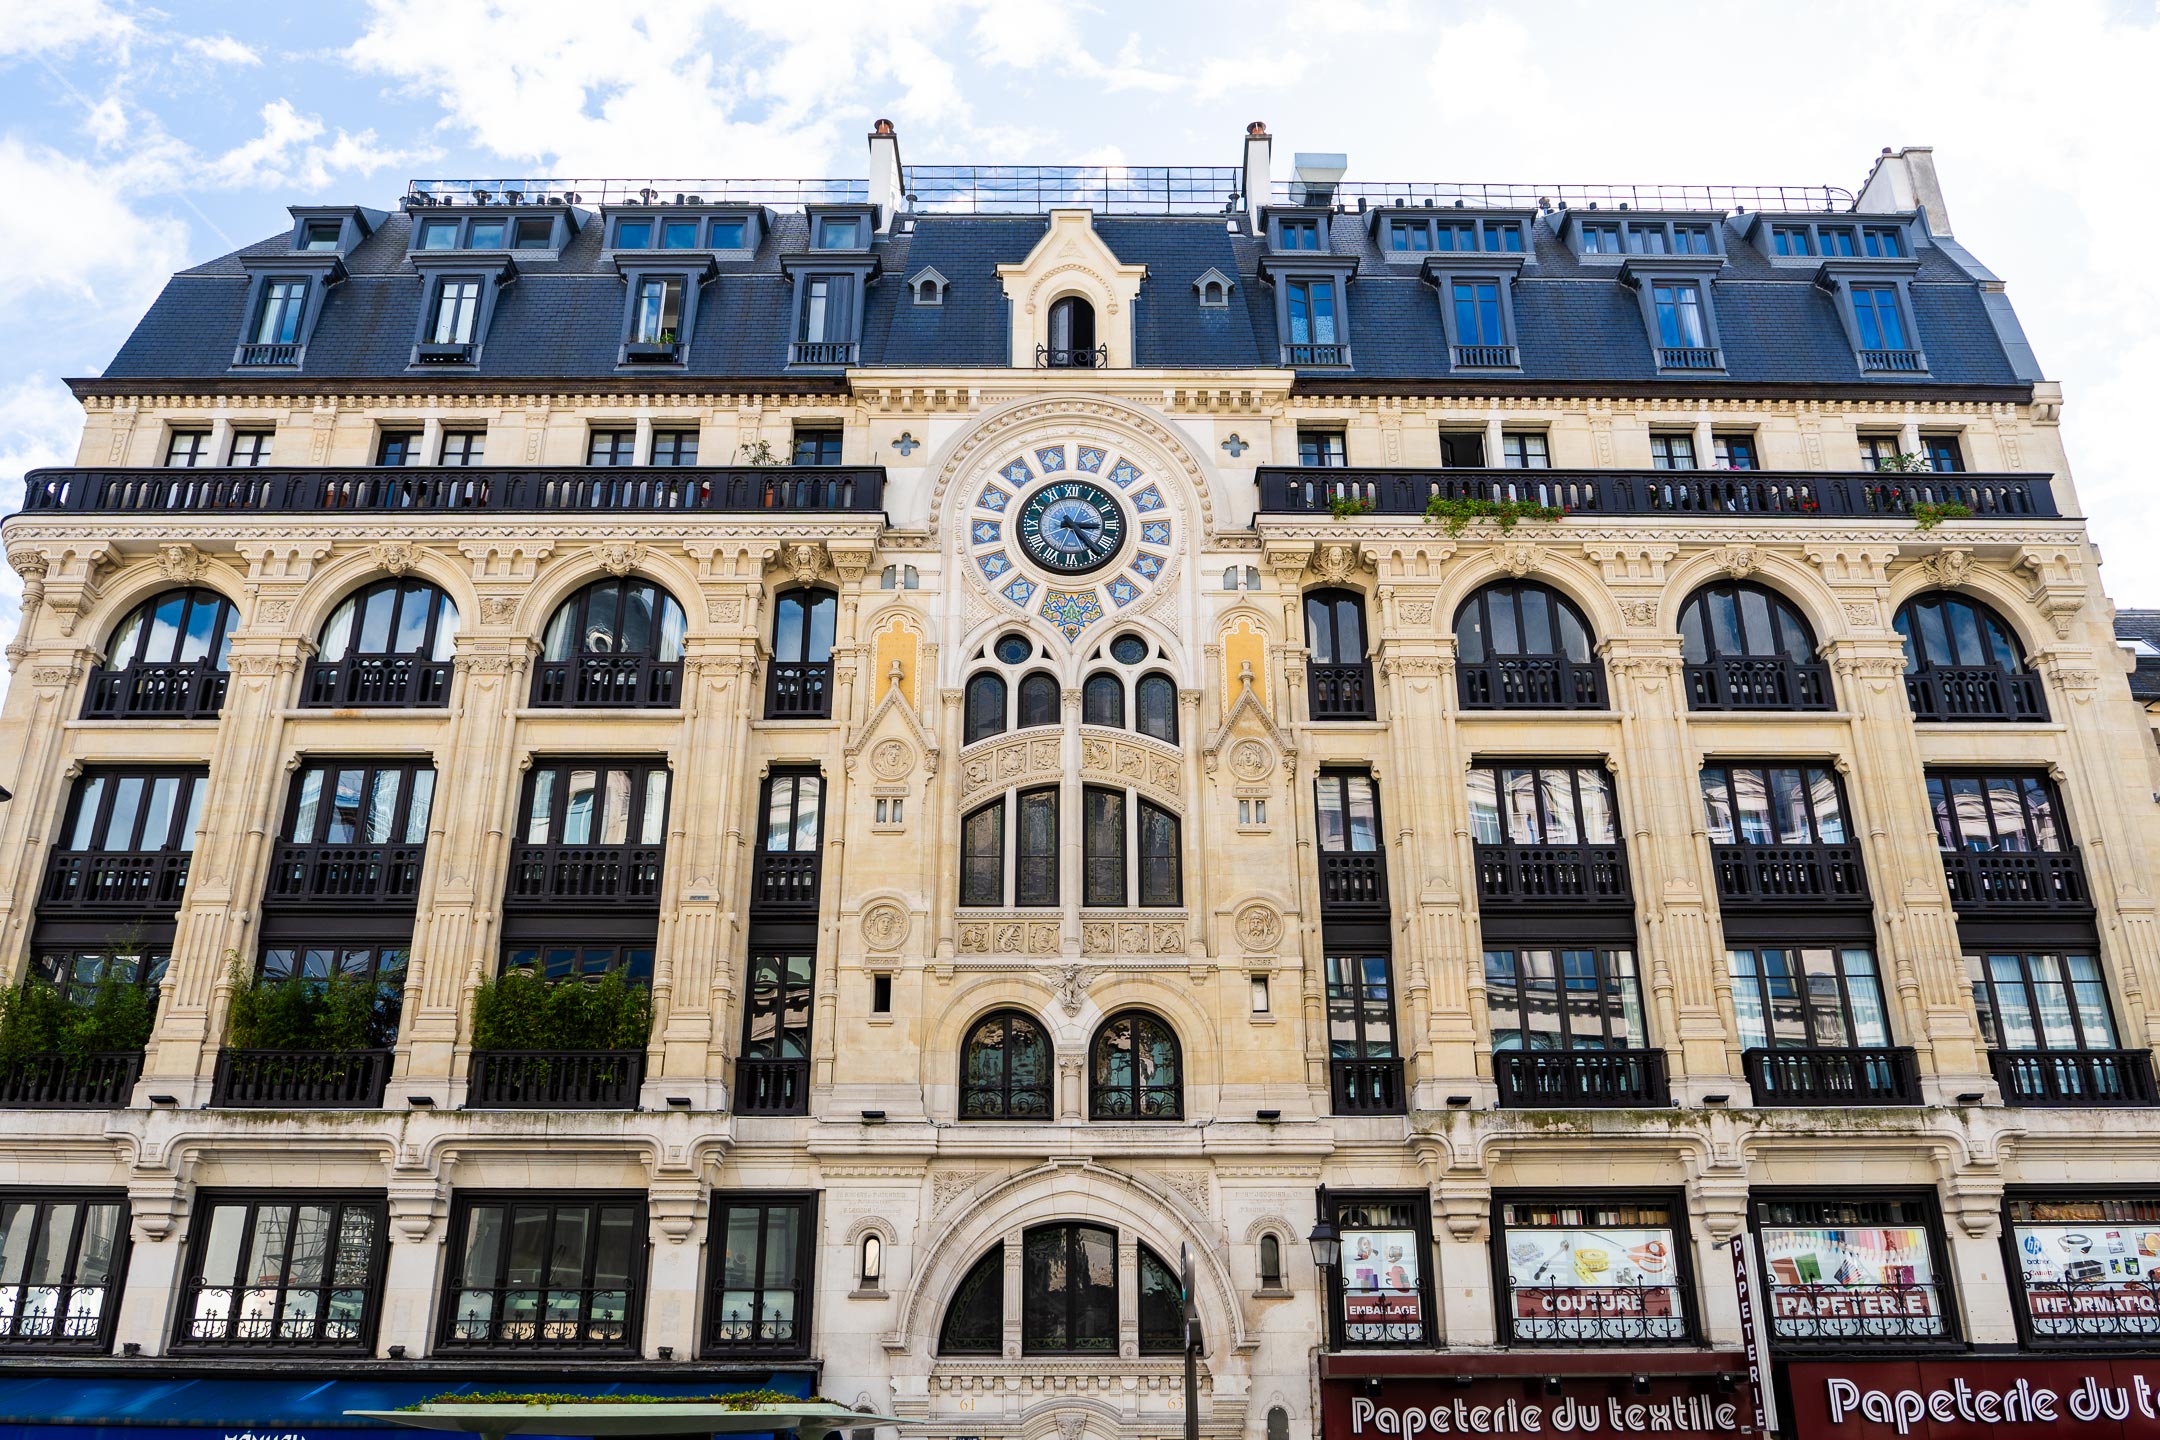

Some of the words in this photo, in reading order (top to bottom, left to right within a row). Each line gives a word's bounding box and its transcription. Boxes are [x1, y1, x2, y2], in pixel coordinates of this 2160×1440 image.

[1046, 489, 1059, 502] XI
[1064, 486, 1079, 497] XII
[1087, 491, 1095, 501] I
[1032, 503, 1044, 512] X
[1099, 504, 1111, 513] II
[1026, 519, 1038, 530] IX
[1105, 520, 1117, 530] III
[1066, 553, 1077, 564] VI
[2035, 1295, 2160, 1313] INFORMATIQ
[1733, 1239, 1766, 1427] PAPETERIE
[960, 1398, 975, 1412] 61
[1167, 1397, 1184, 1409] 63
[1827, 1378, 2059, 1434] Papeterie
[2069, 1376, 2130, 1421] du
[2133, 1375, 2160, 1419] t
[1351, 1397, 1542, 1440] Papeterie
[1552, 1397, 1600, 1431] du
[1608, 1394, 1737, 1431] textile
